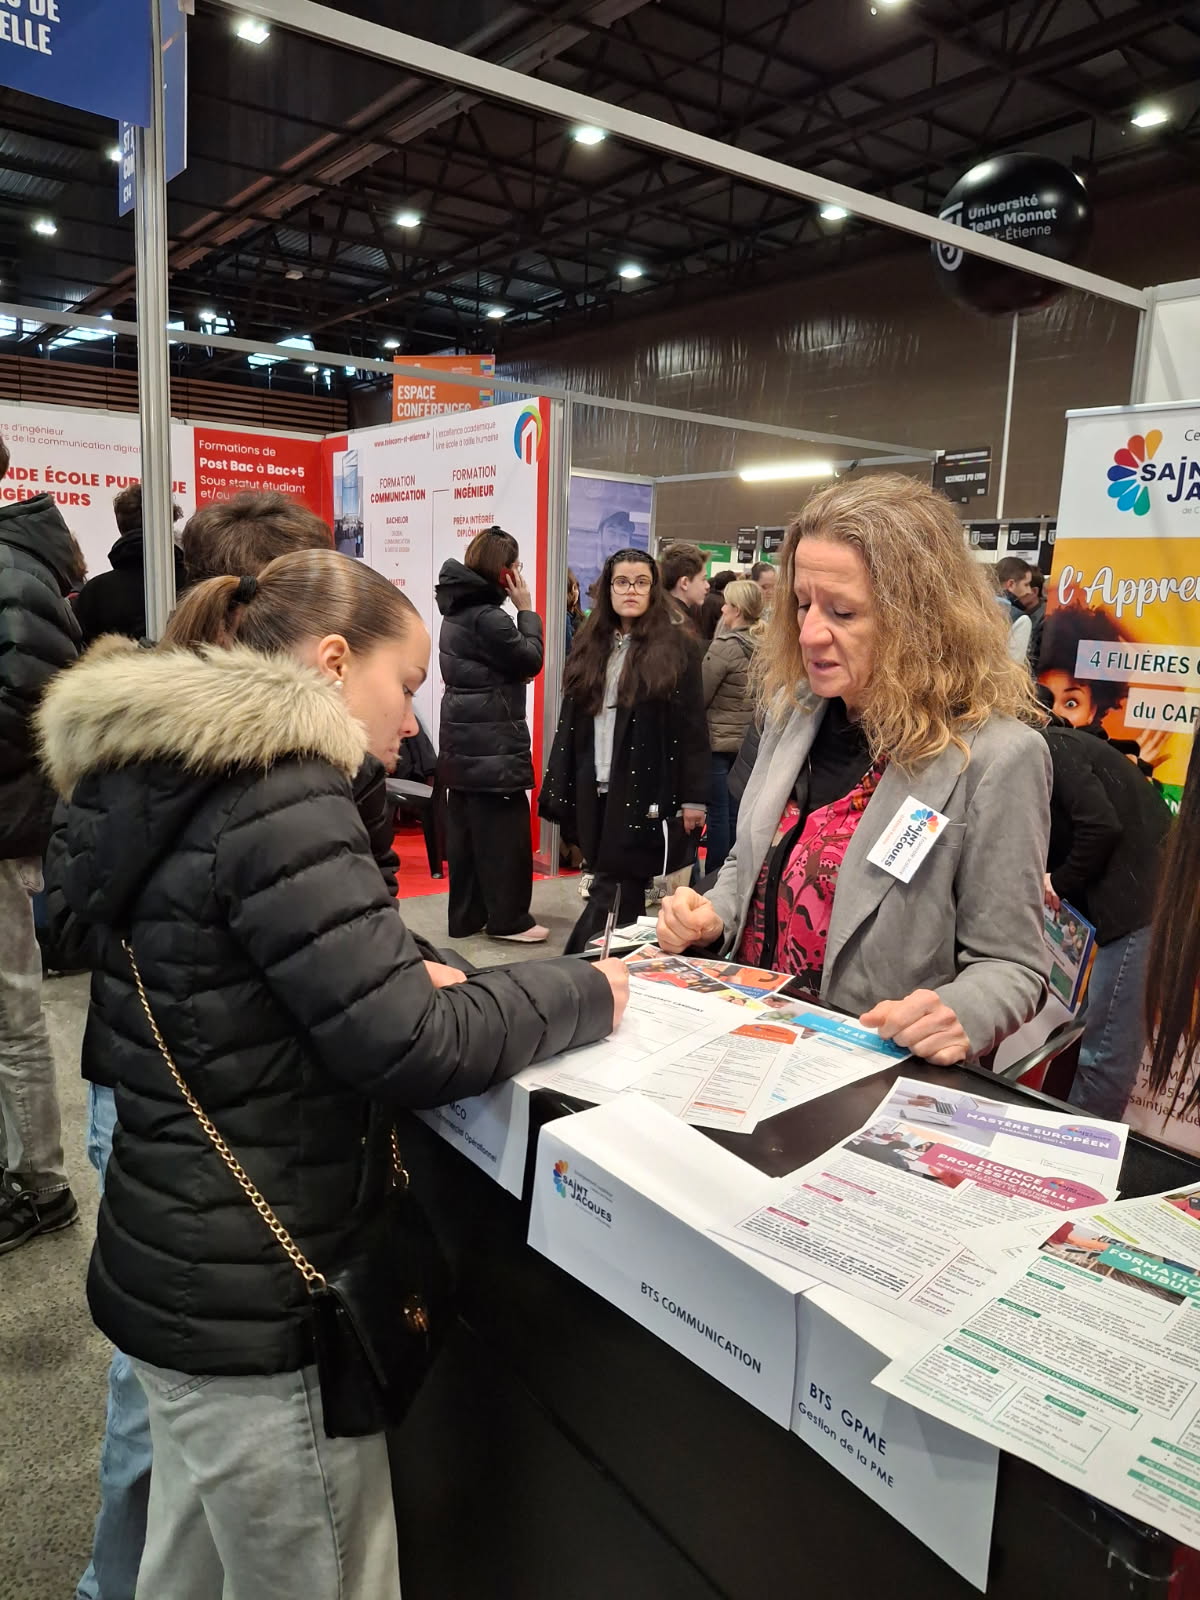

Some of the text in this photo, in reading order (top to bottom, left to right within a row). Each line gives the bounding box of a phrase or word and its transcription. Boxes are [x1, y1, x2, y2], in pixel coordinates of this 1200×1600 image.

[968, 194, 1039, 219] Université
[968, 208, 1057, 233] Jean Monnet
[398, 385, 436, 400] ESPACE
[12, 423, 64, 436] d'ingénieur
[12, 434, 25, 443] de
[27, 435, 36, 443] la
[38, 437, 111, 450] communication
[199, 440, 276, 456] Formations de
[45, 466, 100, 487] ÉCOLE
[200, 457, 305, 477] Post Bac à Bac+5
[452, 465, 496, 480] FORMATION
[200, 475, 305, 494] Sous statut étudiant
[380, 475, 415, 488] FORMATION
[454, 483, 494, 499] INGÉNIEUR
[371, 489, 426, 503] COMMUNICATION
[386, 516, 408, 524] BACHELOR
[1090, 651, 1100, 667] 4
[1107, 649, 1190, 674] FILIÈRES
[1133, 701, 1156, 719] du
[966, 1112, 1030, 1132] MASTÈRE
[1033, 1126, 1110, 1149] EUROPÉEN
[937, 1153, 1077, 1204] PROFESSIONNELLE
[978, 1159, 1044, 1185] LICENCE
[571, 1192, 612, 1222] JACQUES
[641, 1281, 762, 1374] BTS COMMUNICATION
[809, 1382, 886, 1455] BTS GPME
[798, 1402, 894, 1488] Gestion de la PME
